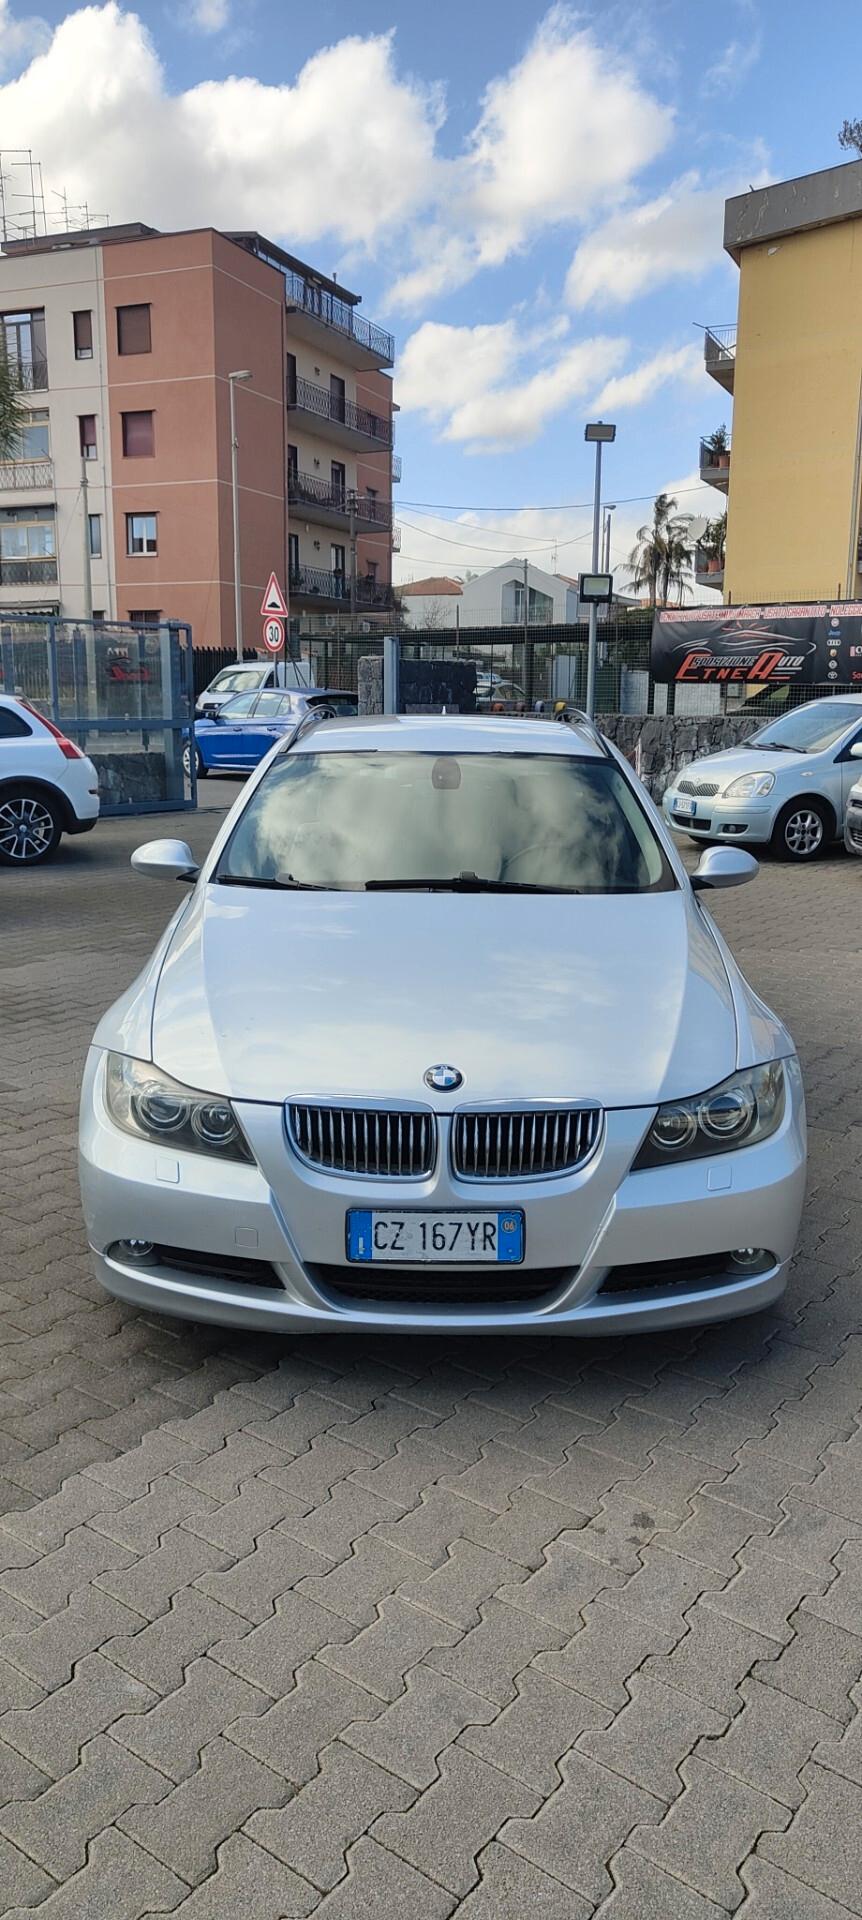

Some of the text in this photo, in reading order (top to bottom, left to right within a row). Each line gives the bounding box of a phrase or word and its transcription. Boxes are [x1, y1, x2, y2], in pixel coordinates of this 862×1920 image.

[269, 625, 279, 642] 30
[374, 1221, 497, 1251] CZ 167YR
